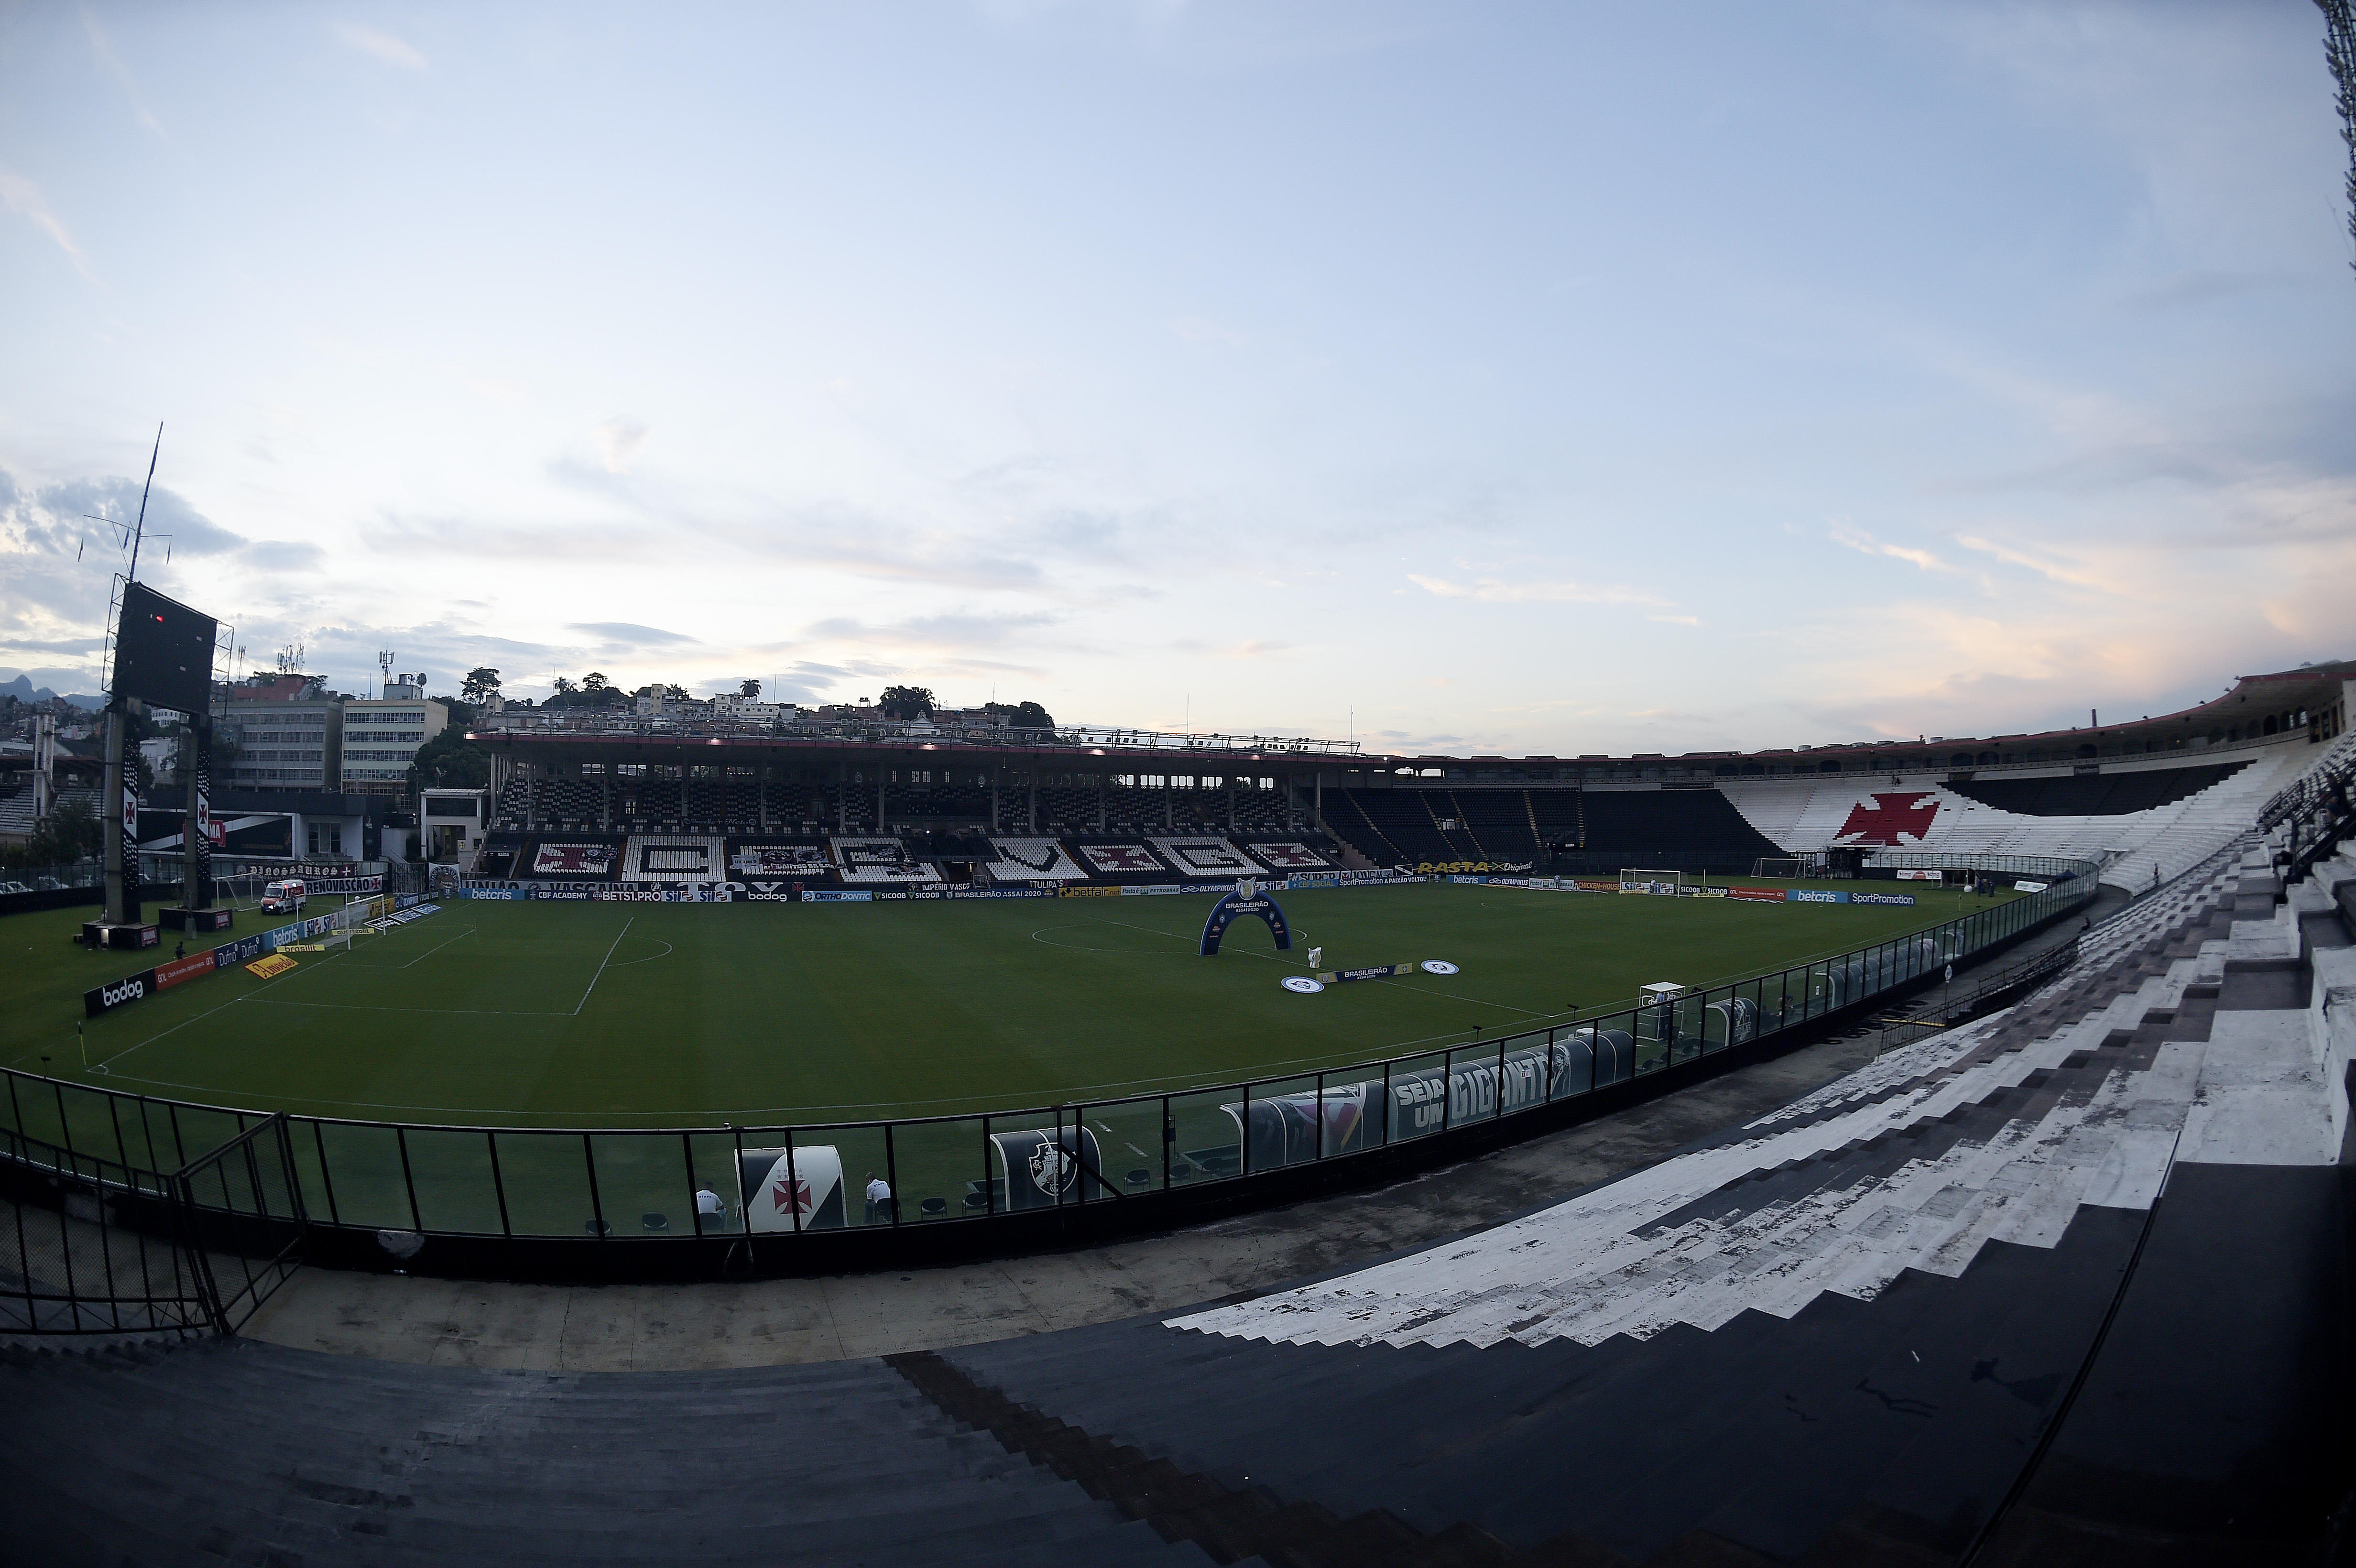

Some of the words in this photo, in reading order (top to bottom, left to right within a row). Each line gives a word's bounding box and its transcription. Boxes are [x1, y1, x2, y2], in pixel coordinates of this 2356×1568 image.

[250, 865, 338, 876] DINOSSAUROS
[1418, 861, 1489, 874] RASTA
[1504, 861, 1533, 873] Original
[306, 877, 369, 893] RENOVASCÃO
[1339, 878, 1383, 887] SportPromotion
[1453, 875, 1479, 884] betcris
[922, 882, 947, 891] IMPÉRIO
[1265, 882, 1276, 890] Sil
[472, 889, 512, 900] betcris
[602, 891, 661, 901] BETS1.PRO
[666, 892, 681, 901] Sil
[699, 892, 716, 901] Sil
[748, 891, 787, 902] bodog
[1798, 890, 1836, 903] betcris
[1853, 893, 1913, 904] SportPromotion
[273, 927, 297, 947] betcris
[241, 944, 258, 958] Dufrio
[285, 944, 316, 952] brasilit
[218, 951, 236, 967] Dufrio
[253, 958, 295, 977] Amoedo
[1344, 967, 1388, 978] BRASILEIRÃO
[102, 979, 143, 1006] bodog
[1396, 1078, 1445, 1106] SEJA
